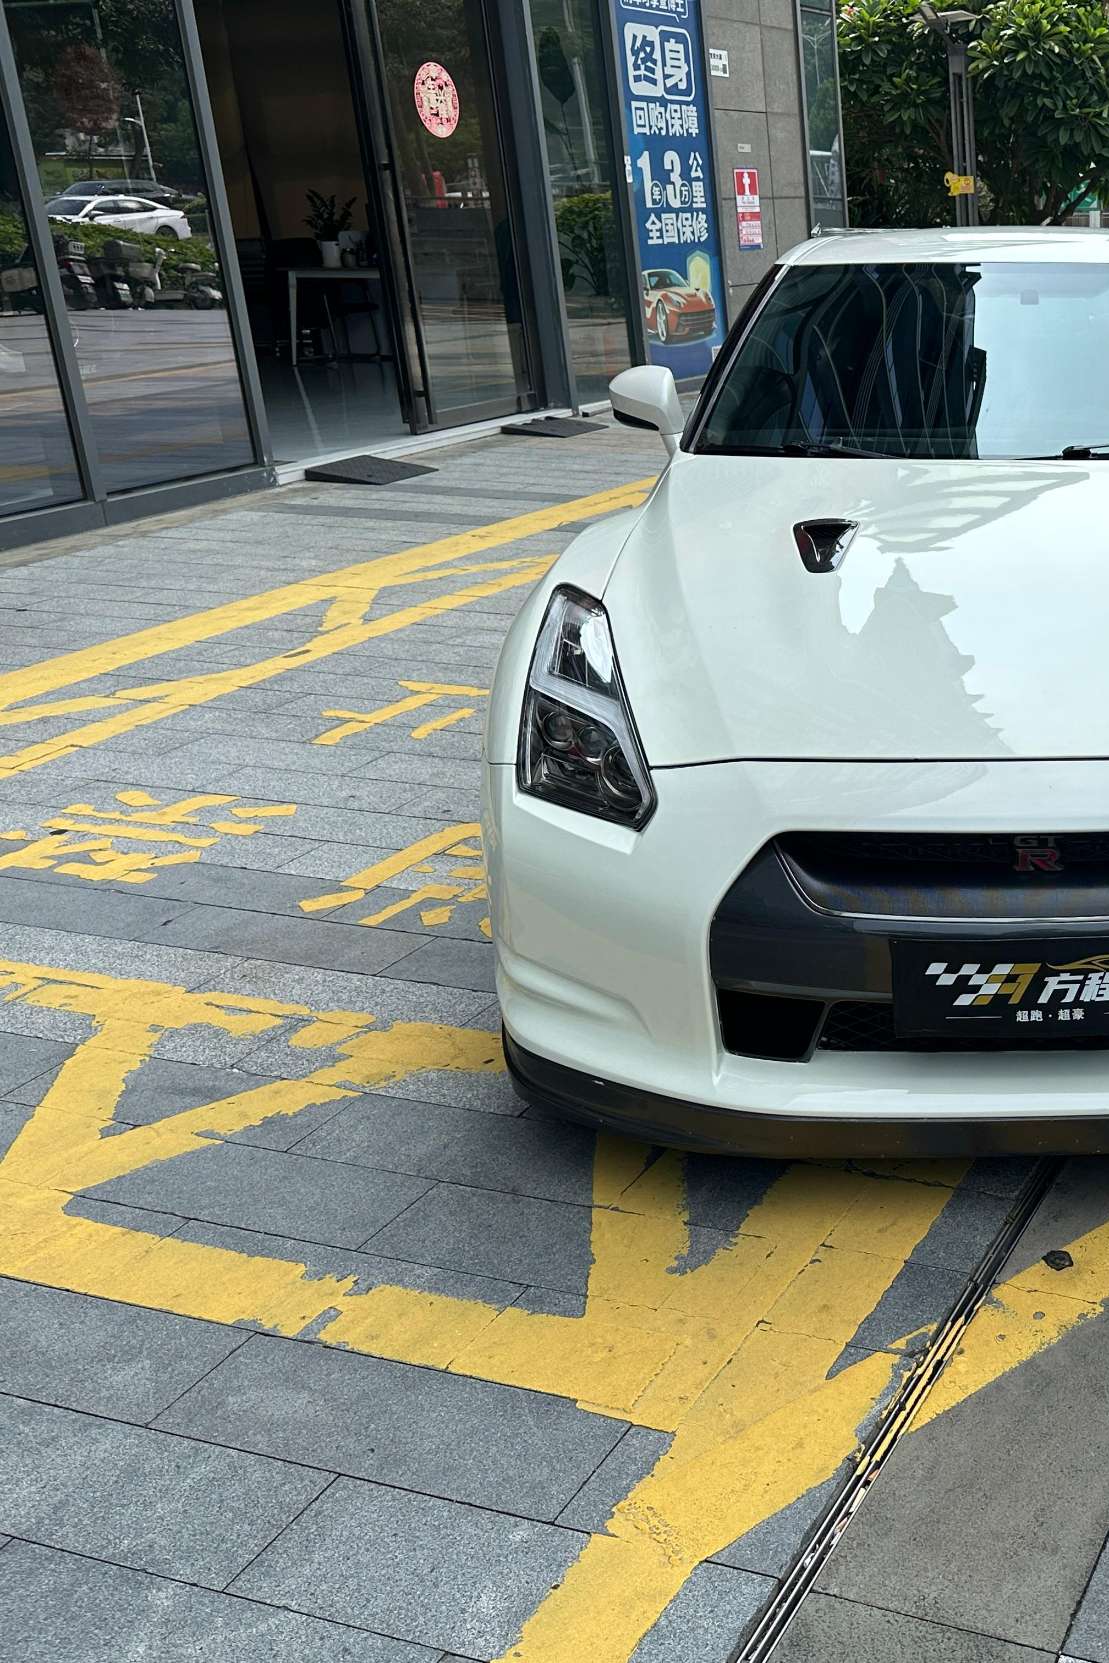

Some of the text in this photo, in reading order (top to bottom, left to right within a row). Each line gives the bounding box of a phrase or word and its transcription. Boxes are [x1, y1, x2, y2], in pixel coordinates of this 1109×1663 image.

[630, 33, 689, 90] 终身
[631, 101, 699, 137] 回购保障
[645, 211, 708, 245] 全国保修
